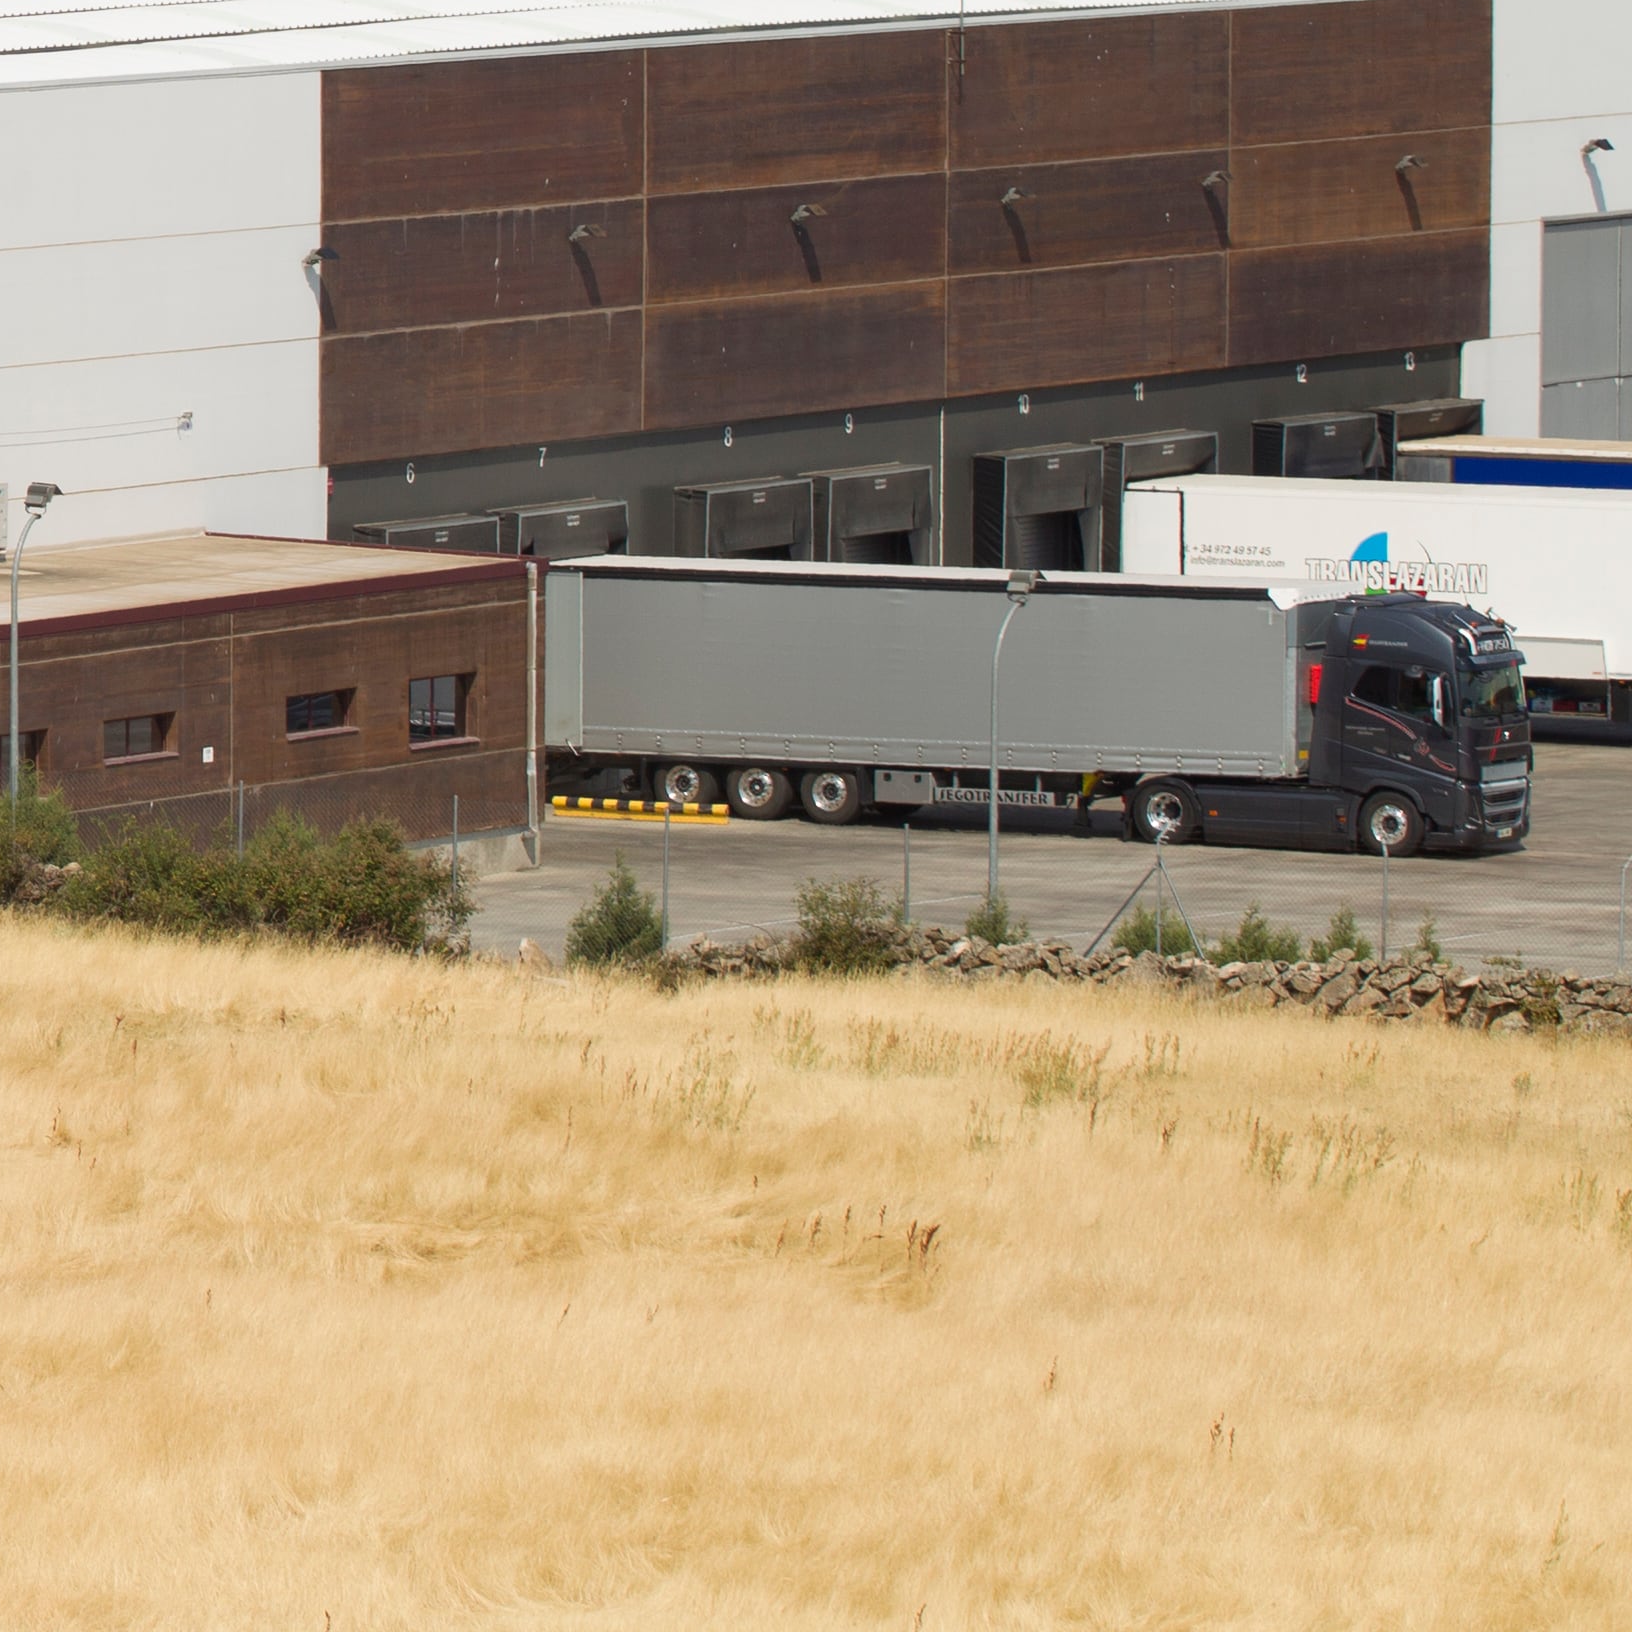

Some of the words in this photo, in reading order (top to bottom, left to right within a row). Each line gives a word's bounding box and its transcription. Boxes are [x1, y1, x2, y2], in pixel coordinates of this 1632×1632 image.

[1297, 364, 1307, 383] 12
[1134, 382, 1144, 401] 11
[1018, 394, 1030, 415] 10
[845, 413, 854, 434] 9
[723, 426, 733, 448] 8
[539, 447, 547, 468] 7
[406, 462, 415, 484] 6
[1304, 557, 1488, 594] TRANSLAZARAN
